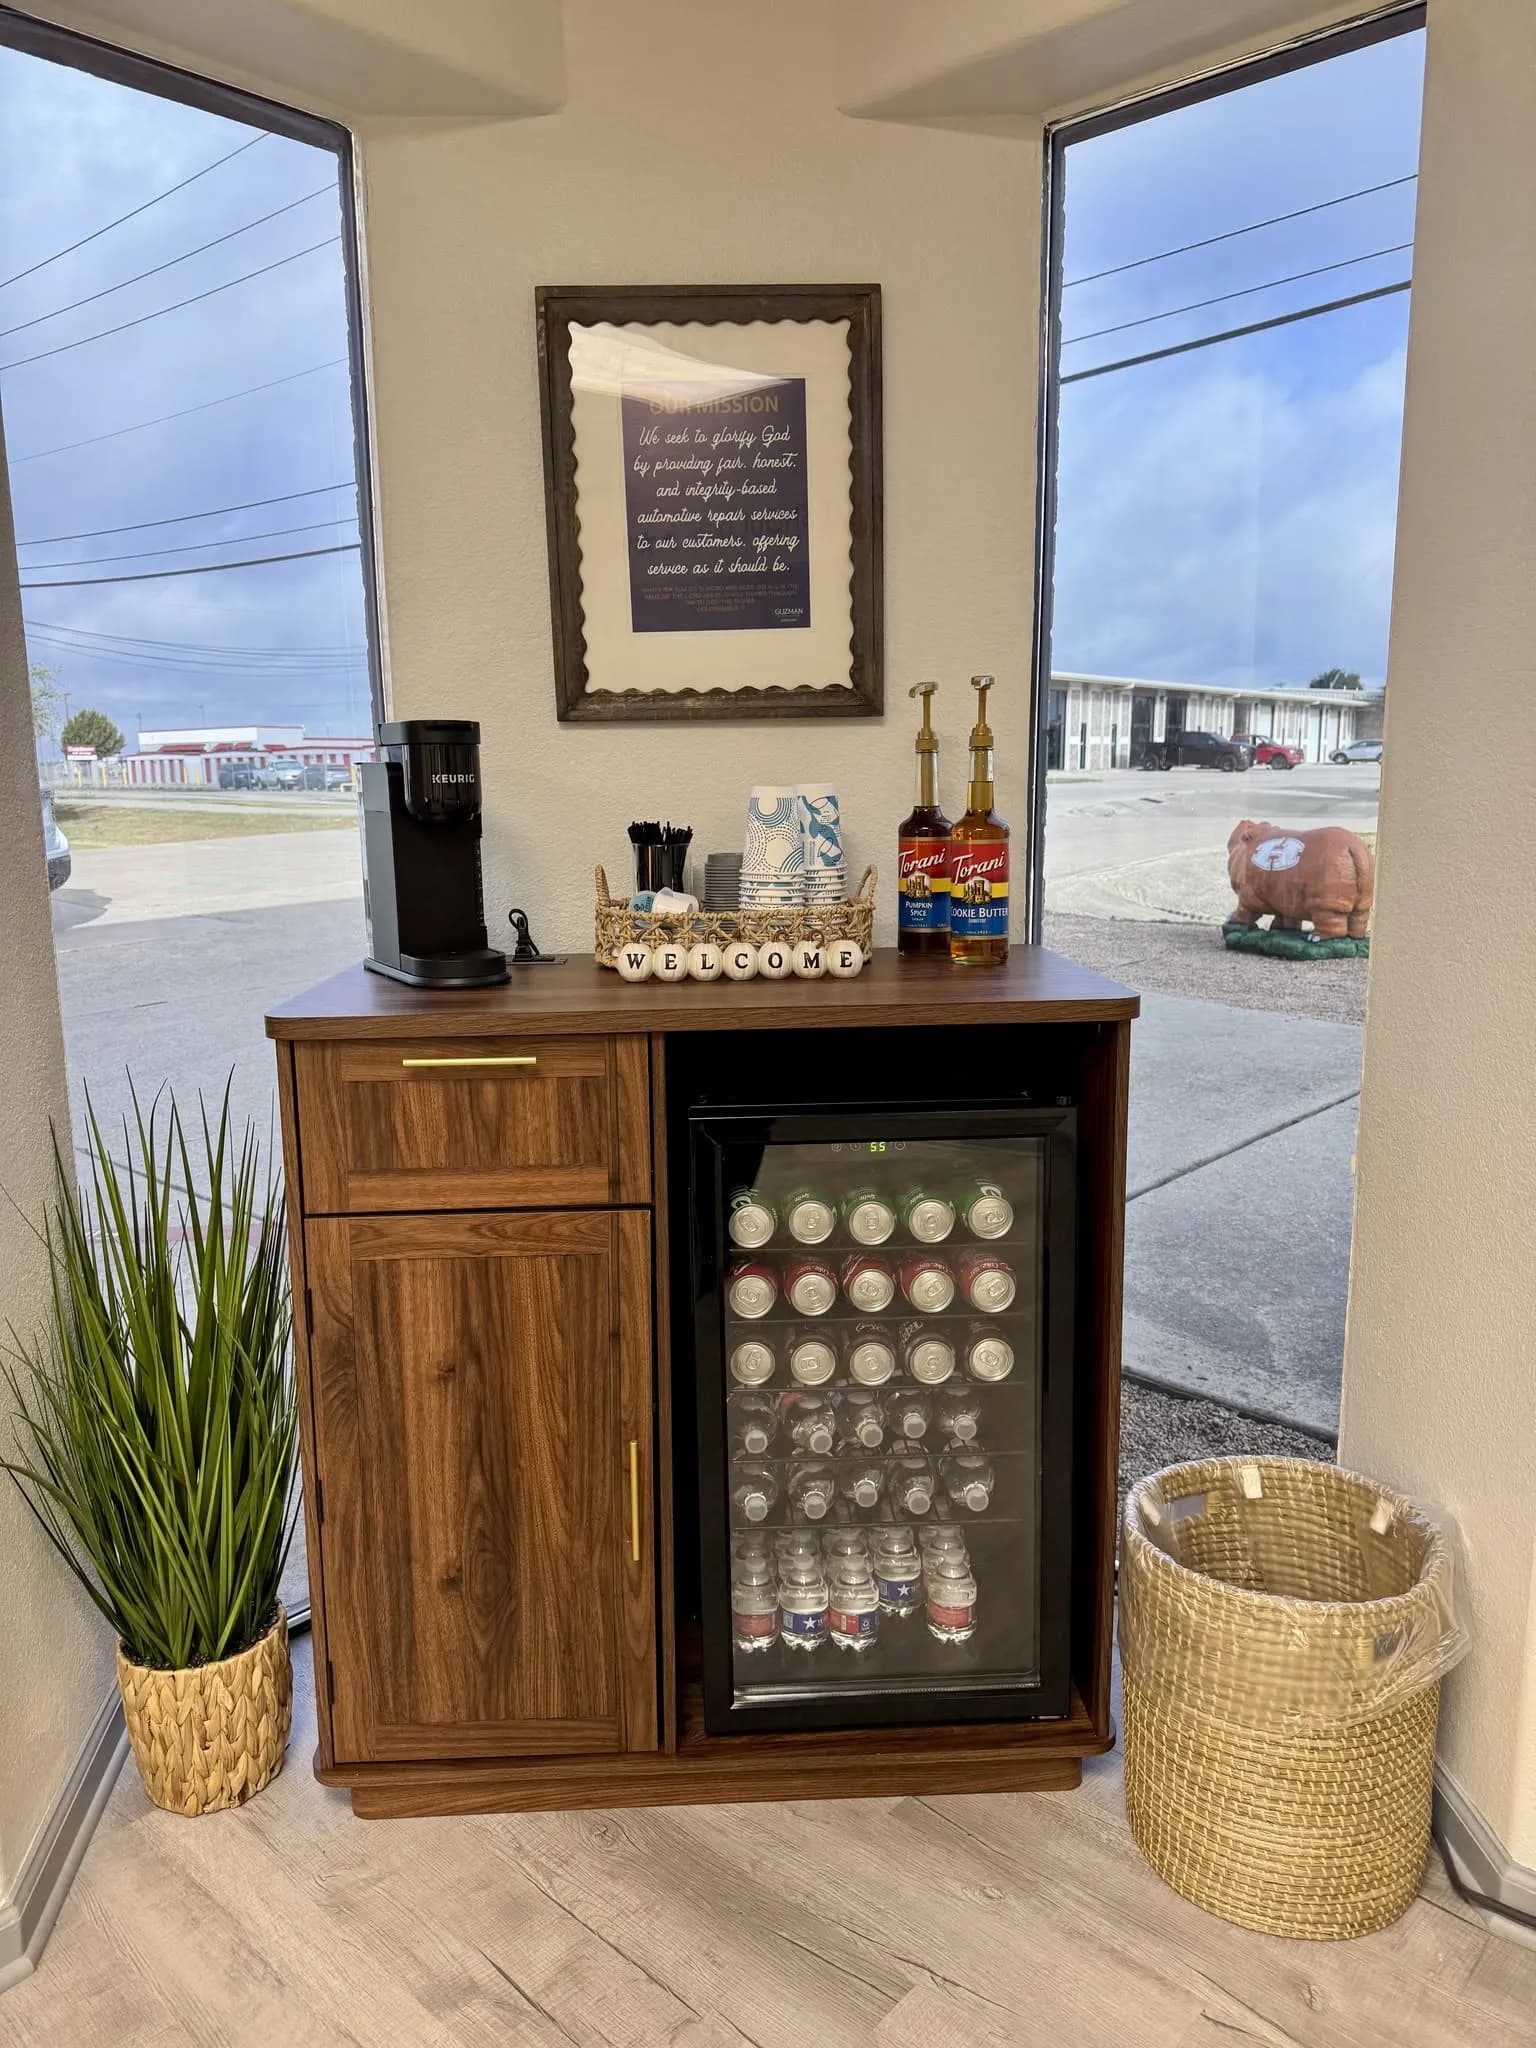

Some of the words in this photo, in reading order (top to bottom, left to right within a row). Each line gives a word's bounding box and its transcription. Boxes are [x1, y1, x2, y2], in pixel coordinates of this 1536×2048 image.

[639, 426, 660, 446] We
[664, 427, 690, 444] seek
[694, 427, 708, 444] to
[712, 426, 757, 450] glorify
[761, 424, 791, 448] God
[633, 454, 650, 478] by
[653, 453, 714, 477] providing
[656, 480, 680, 497] and
[685, 478, 778, 502] integrity-based
[637, 507, 702, 524] automotive
[707, 508, 746, 528] repair
[750, 508, 798, 521] services
[637, 535, 651, 550] to
[655, 536, 677, 549] our
[752, 533, 800, 553] offering
[647, 561, 688, 575] service
[692, 562, 710, 574] as
[713, 558, 724, 574] it
[728, 556, 767, 573] should
[772, 555, 790, 572] be.
[774, 607, 804, 616] GUZMAN
[431, 774, 475, 784] KEURIG
[899, 848, 946, 880] Torani
[953, 851, 1005, 884] Torani
[626, 951, 853, 970] WELCOME
